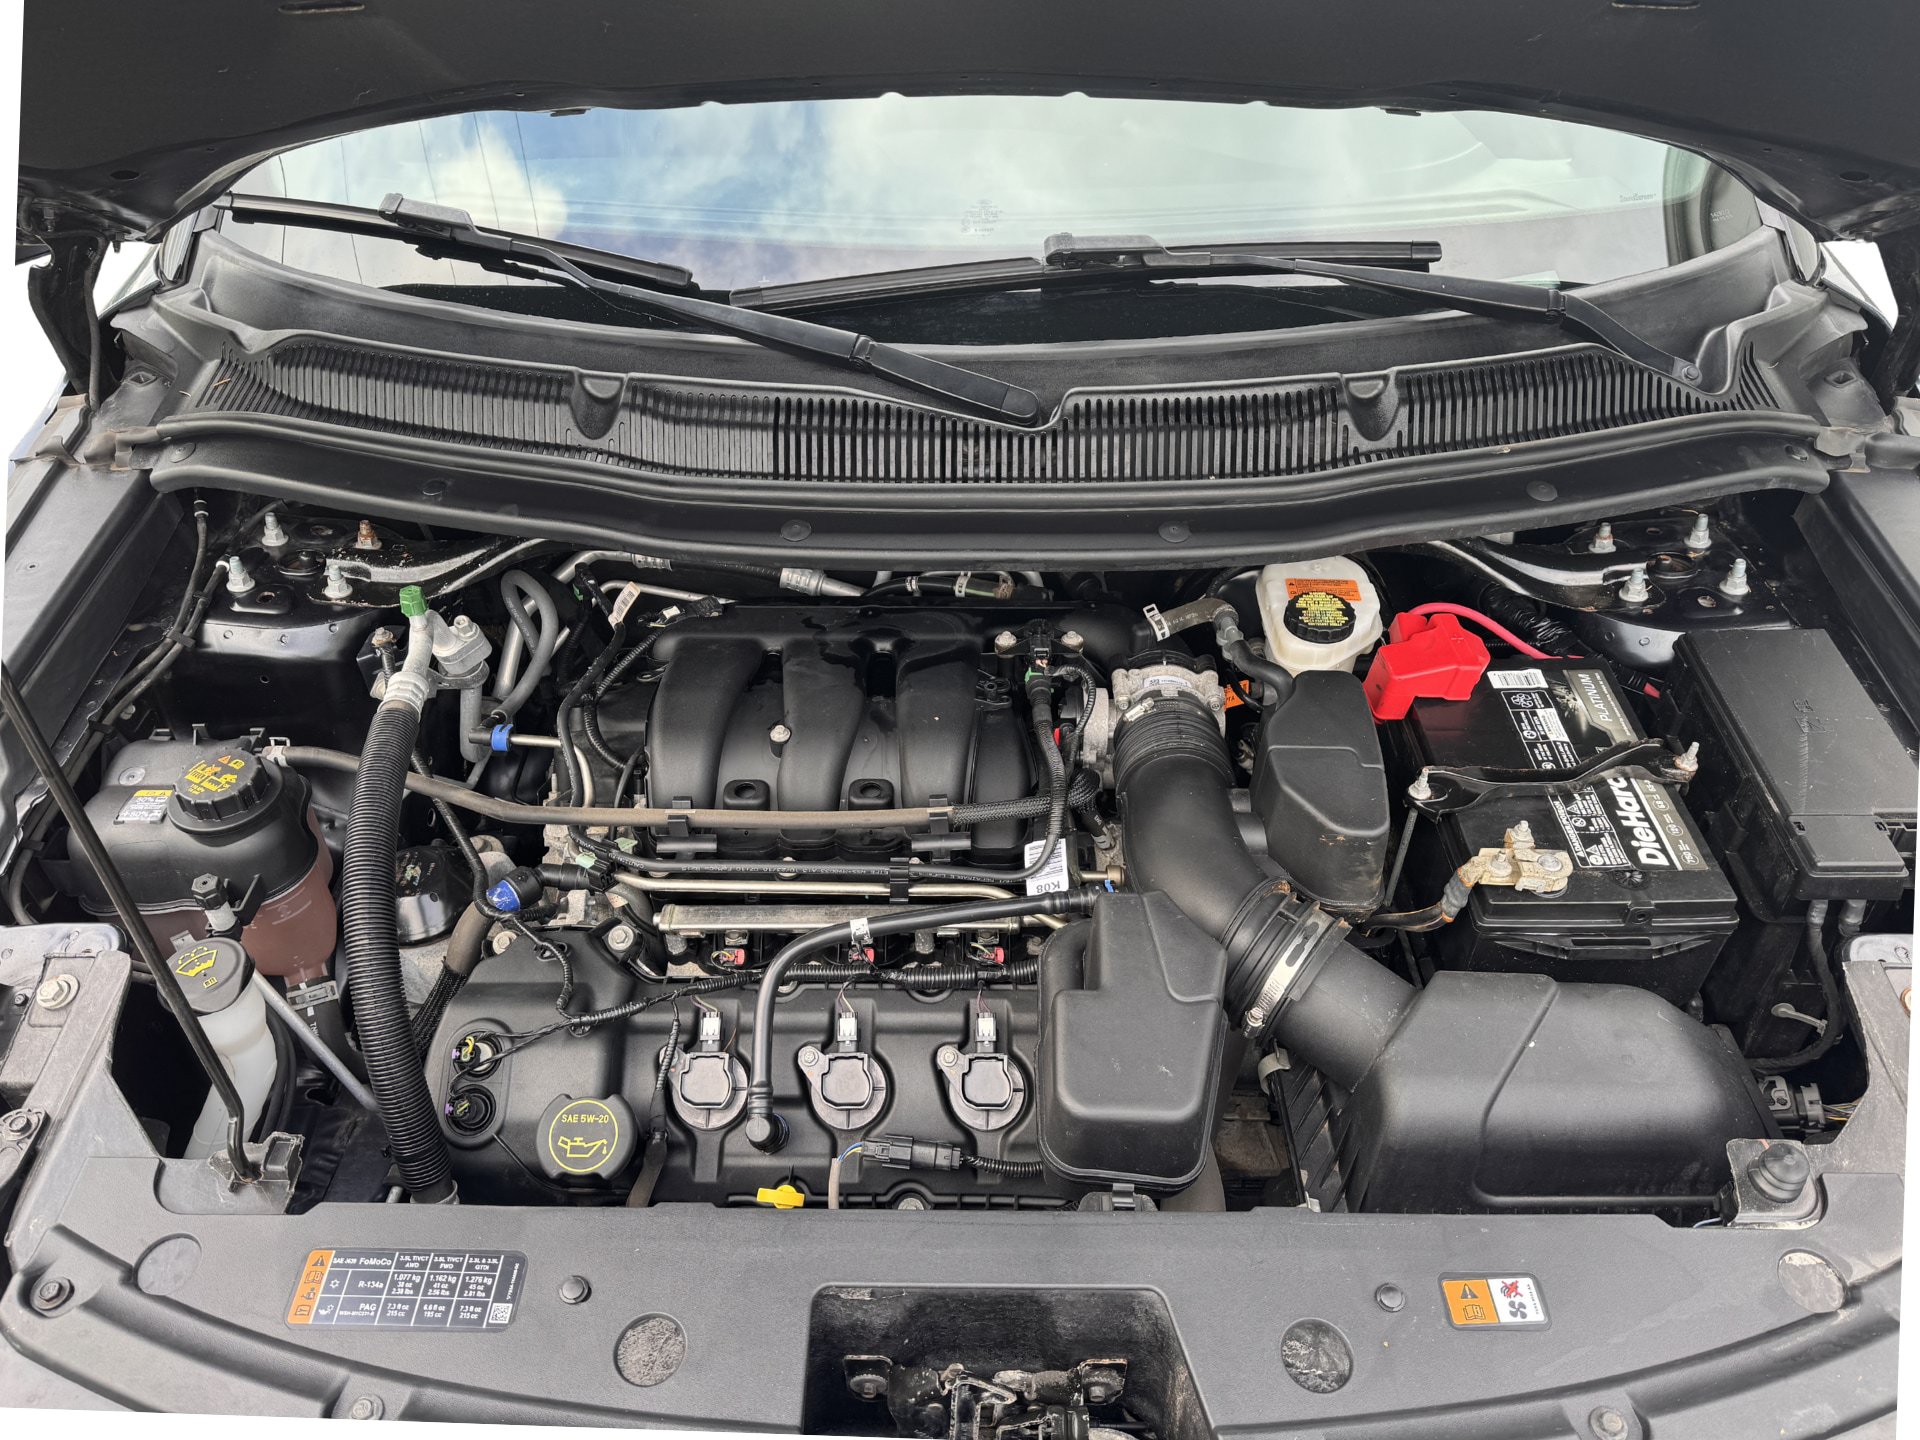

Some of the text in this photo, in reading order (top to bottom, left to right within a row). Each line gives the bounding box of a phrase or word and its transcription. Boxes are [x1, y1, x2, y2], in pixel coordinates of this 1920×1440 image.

[1578, 672, 1613, 722] PLATINUM
[1683, 851, 1696, 864] 750
[1036, 880, 1060, 893] K08
[561, 1114, 609, 1123] SAE 5W-20
[412, 1274, 421, 1282] kg
[448, 1275, 457, 1283] kg
[483, 1276, 492, 1285] kg
